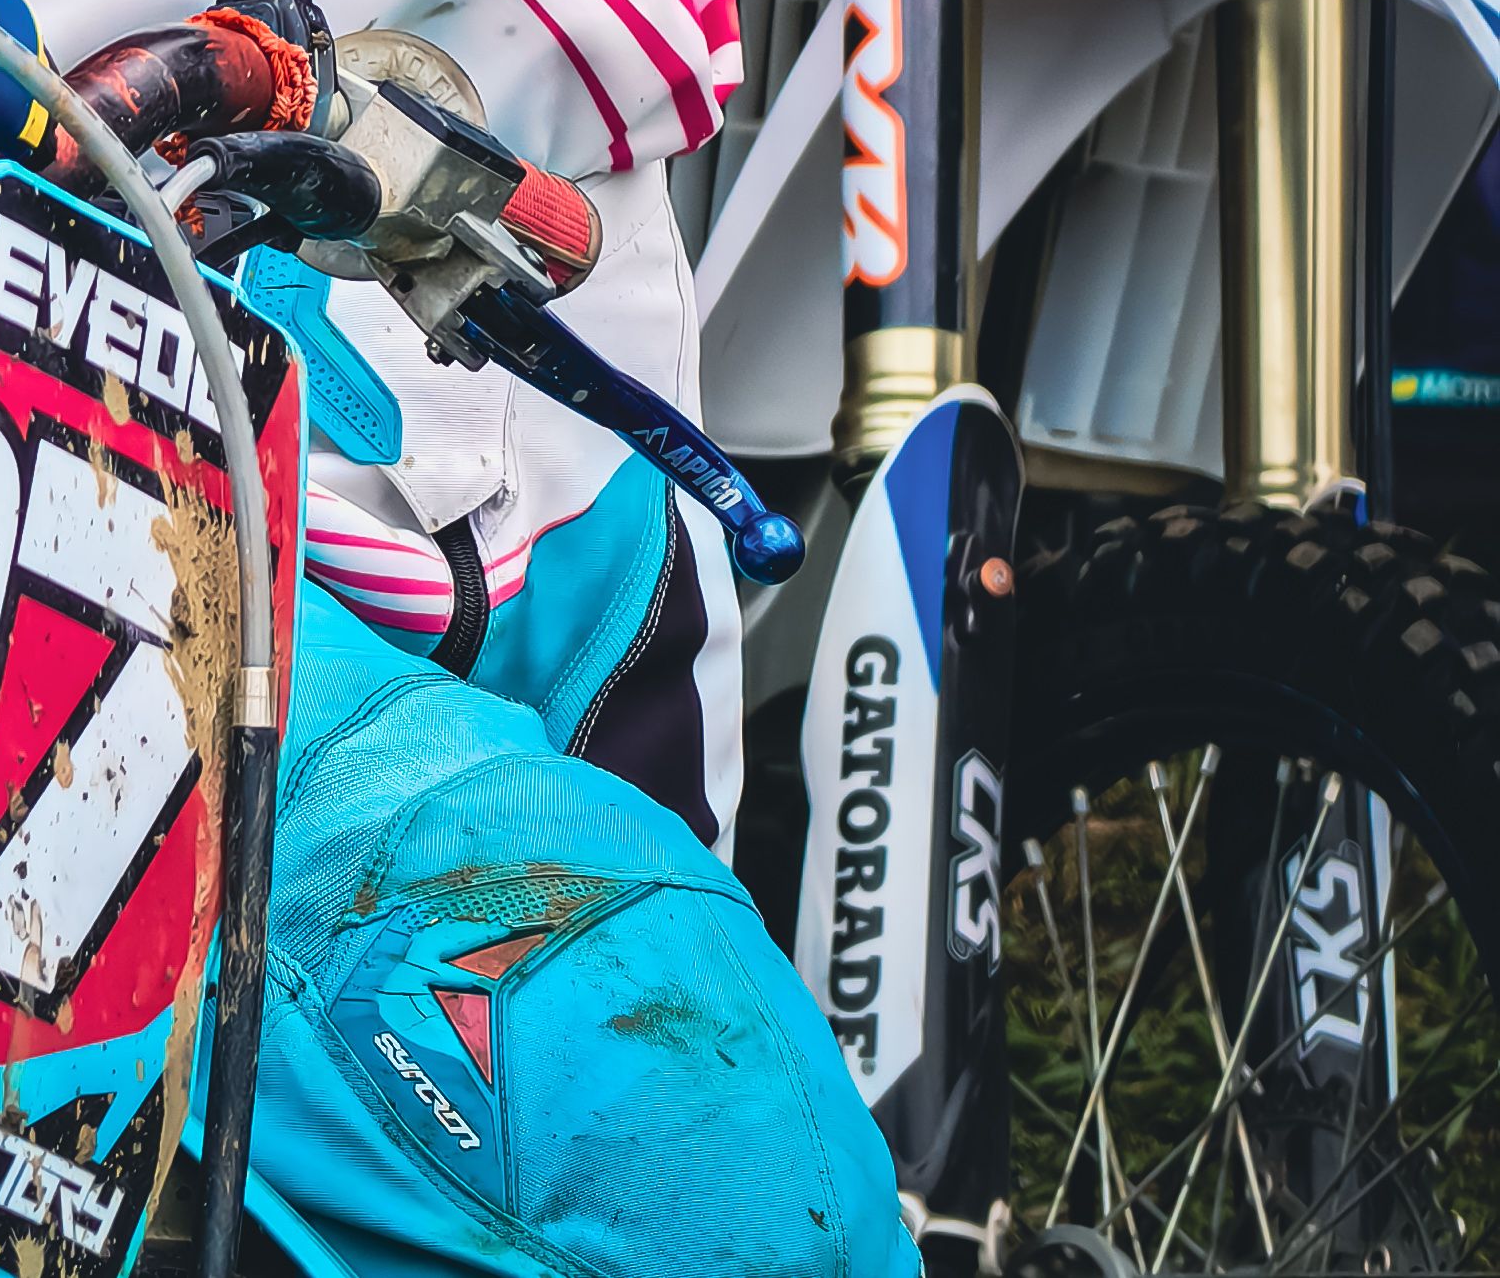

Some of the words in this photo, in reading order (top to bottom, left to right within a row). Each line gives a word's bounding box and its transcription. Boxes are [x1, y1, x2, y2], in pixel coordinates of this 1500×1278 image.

[662, 445, 742, 511] APICO
[828, 633, 900, 1059] GATORADE
[953, 749, 1002, 973] CKS
[1287, 843, 1368, 1053] CKS
